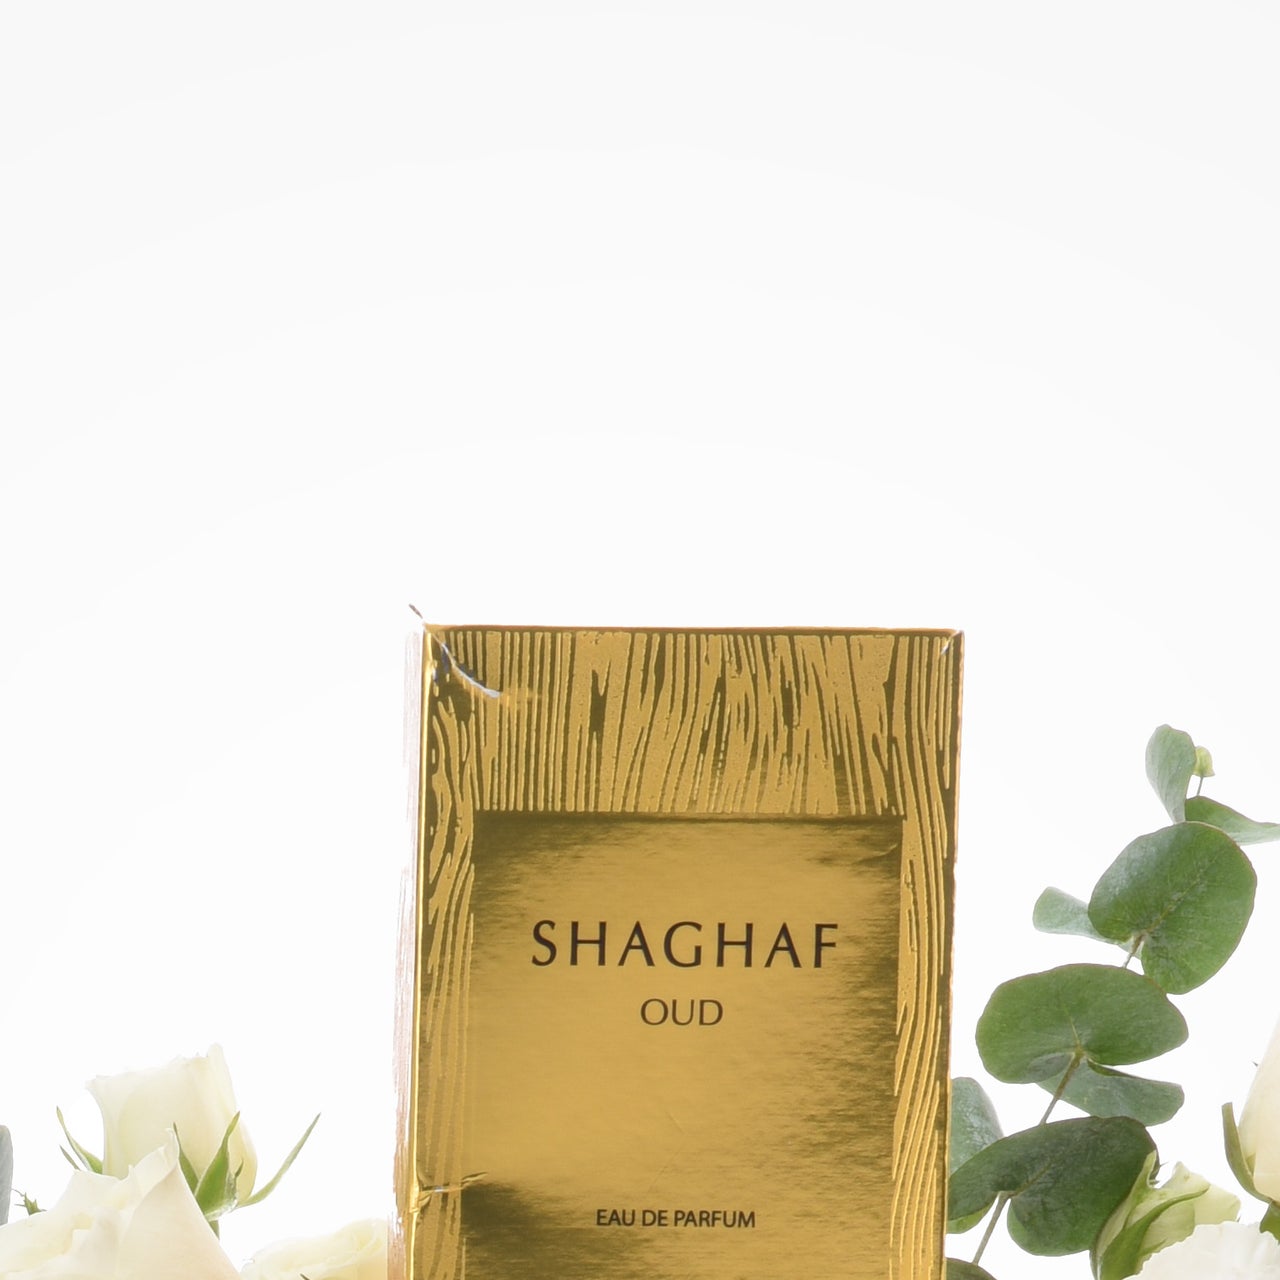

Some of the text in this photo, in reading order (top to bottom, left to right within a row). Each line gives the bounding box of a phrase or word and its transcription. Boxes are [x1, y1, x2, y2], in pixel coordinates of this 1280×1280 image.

[531, 919, 838, 969] SHAGHAF
[640, 998, 724, 1027] OUD
[595, 1208, 756, 1229] EAU DE PARFUM
